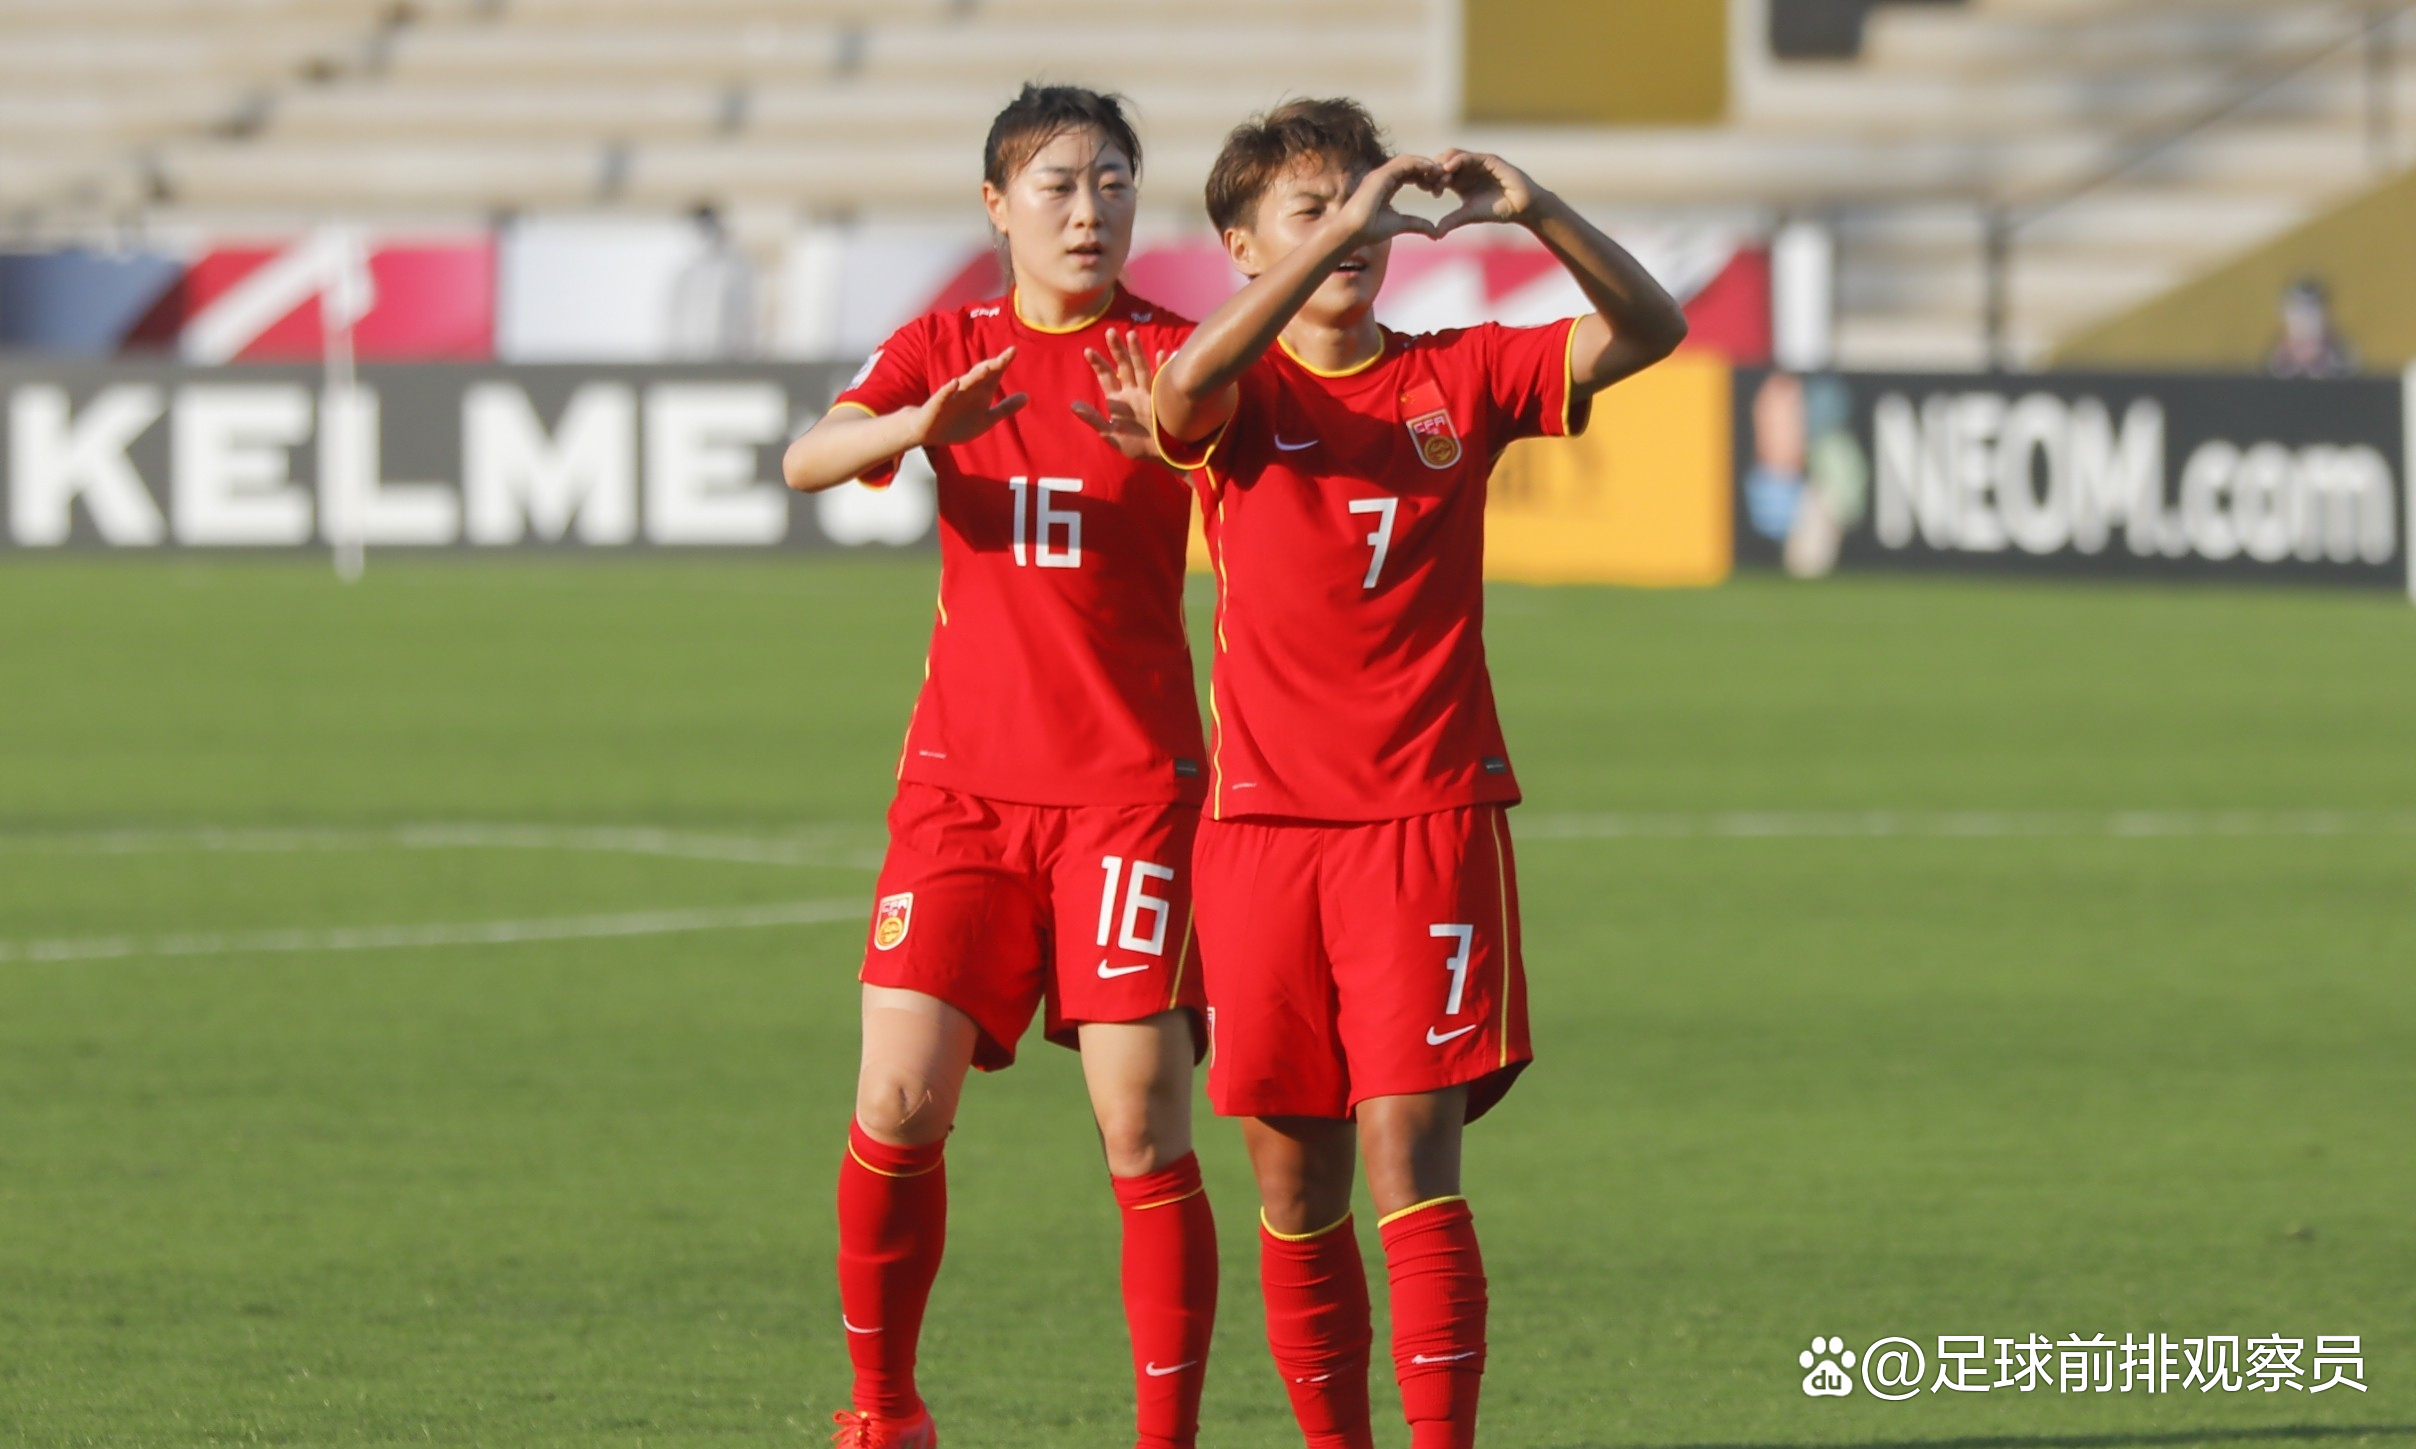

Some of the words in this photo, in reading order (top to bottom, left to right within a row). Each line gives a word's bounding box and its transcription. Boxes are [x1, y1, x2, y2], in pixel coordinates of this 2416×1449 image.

[7, 381, 788, 546] KELME
[1413, 415, 1446, 434] CFA
[1008, 476, 1083, 568] 16
[1874, 392, 2395, 564] NEOM.com
[1349, 498, 1398, 588] 7
[1096, 855, 1174, 956] 16
[1429, 924, 1474, 1015] 7
